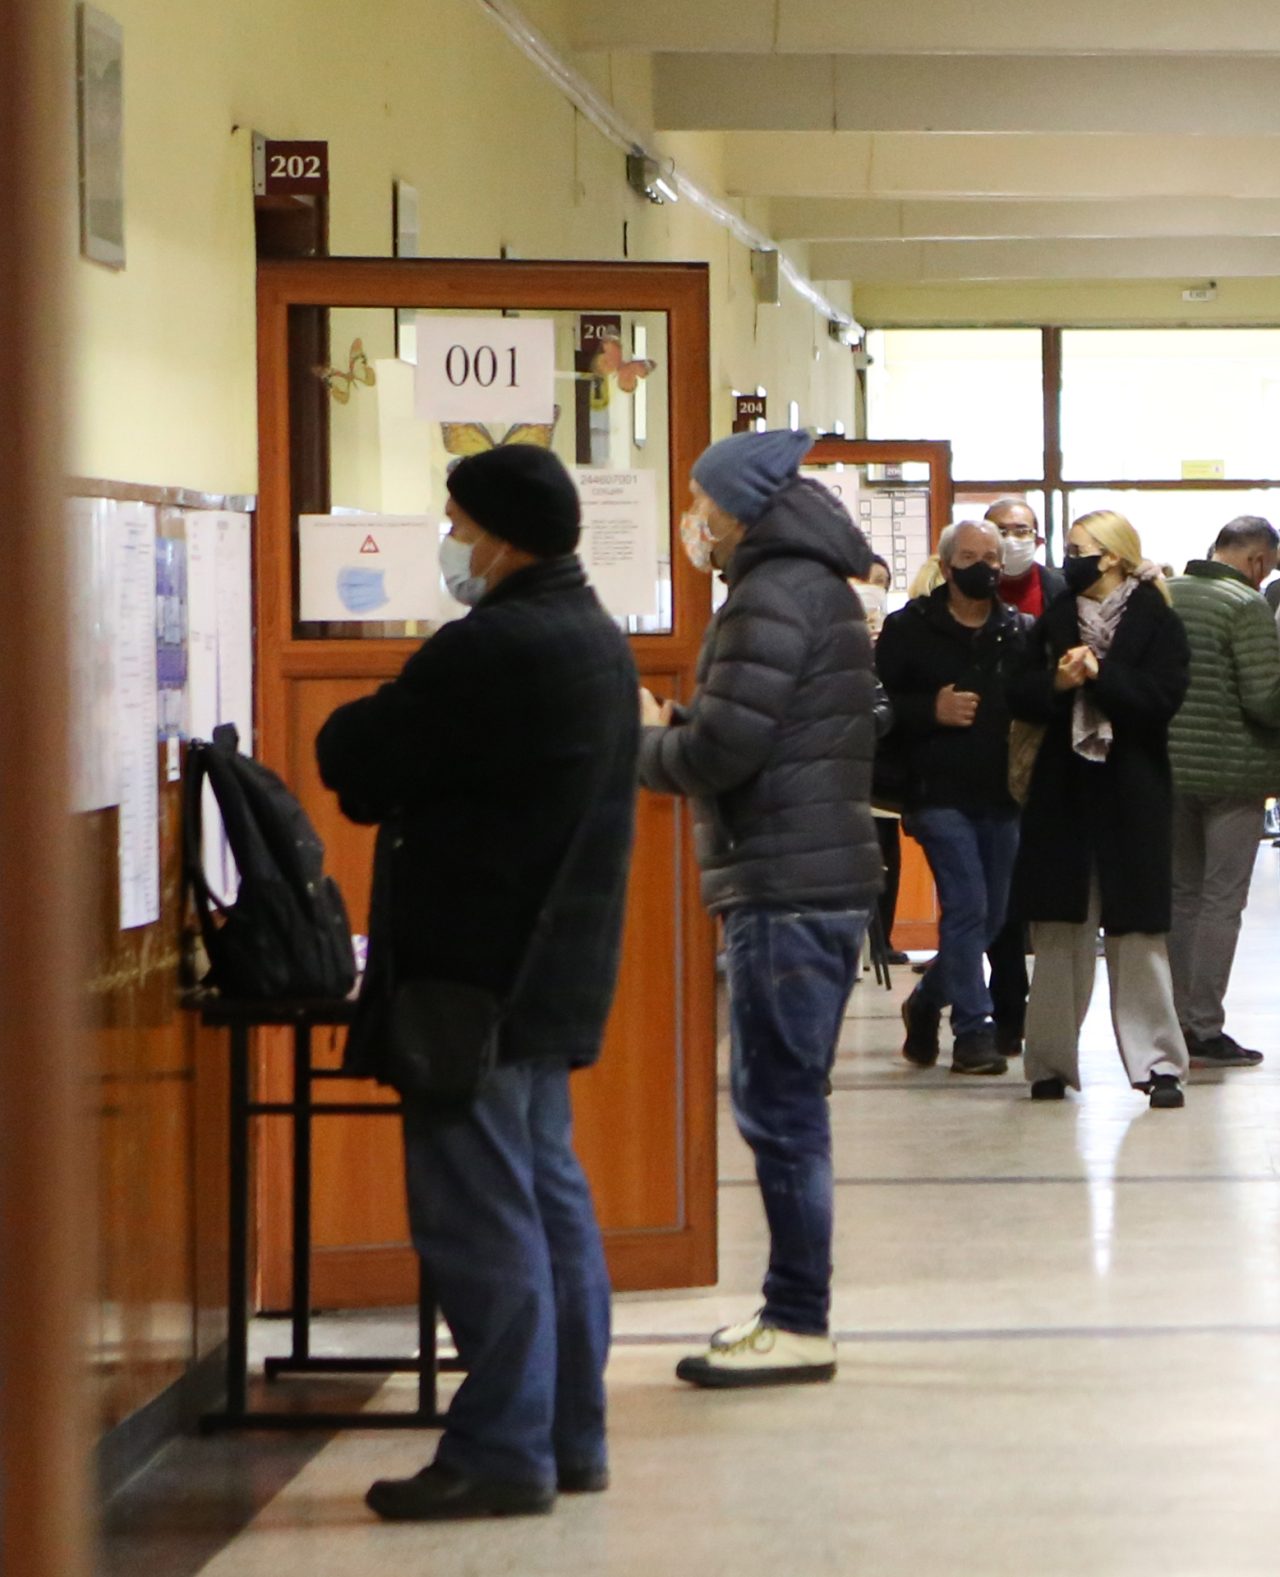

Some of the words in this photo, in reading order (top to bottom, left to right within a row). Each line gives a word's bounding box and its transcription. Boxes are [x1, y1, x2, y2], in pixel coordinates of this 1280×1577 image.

[270, 155, 321, 178] 202
[584, 324, 619, 340] 20
[445, 344, 520, 387] 001
[740, 402, 763, 414] 204
